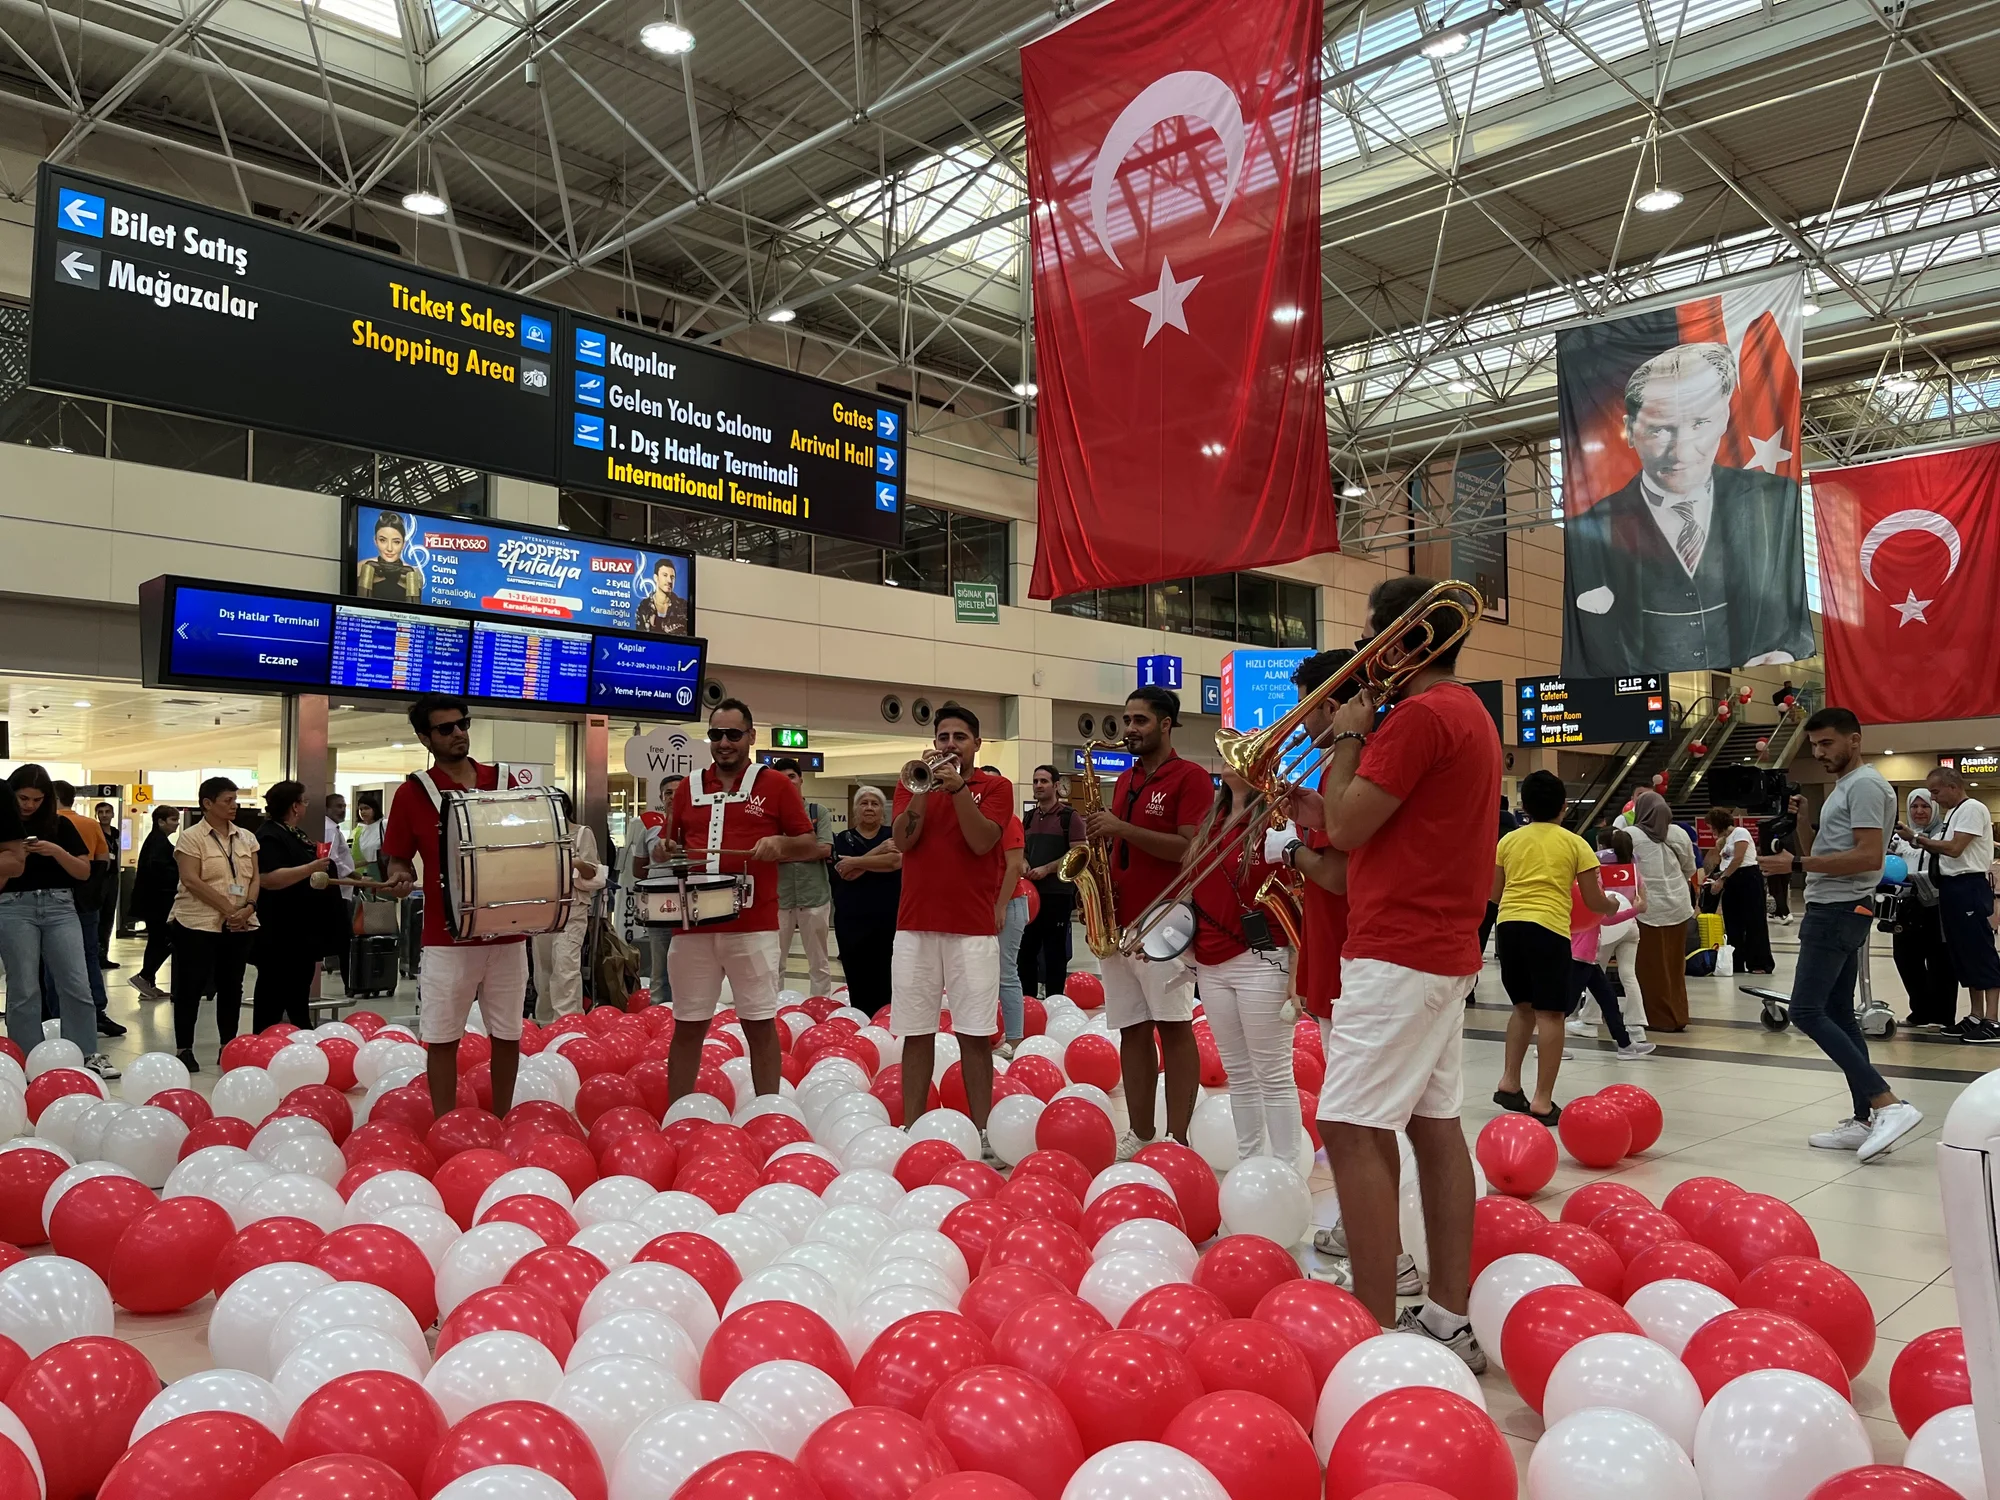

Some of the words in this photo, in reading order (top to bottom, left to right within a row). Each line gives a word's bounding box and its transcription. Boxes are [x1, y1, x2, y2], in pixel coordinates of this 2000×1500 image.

[110, 206, 176, 251] Bilet
[184, 231, 248, 276] Satış
[108, 259, 258, 320] Mağazalar
[390, 282, 454, 322] Ticket
[461, 303, 515, 339] Sales
[352, 321, 459, 375] Shopping
[465, 350, 515, 382] Area
[610, 342, 676, 380] Kapılar
[609, 385, 662, 418] Gelen
[667, 398, 712, 430] Yolcu
[717, 411, 772, 443] Salonu
[833, 402, 874, 431] Gates
[790, 430, 839, 460] Arrival
[845, 442, 873, 468] Hall
[609, 425, 625, 450] 1.
[631, 430, 659, 463] Dış
[665, 437, 719, 470] Hatlar
[724, 451, 798, 487] Terminali
[608, 457, 723, 501] International
[729, 482, 797, 516] Terminal
[804, 498, 810, 518] 1
[425, 537, 456, 549] MELEK
[522, 535, 566, 547] INTERNATIONAL
[507, 539, 579, 561] FOODFEST
[438, 555, 458, 564] Eylül
[432, 565, 457, 575] Cuma
[497, 548, 581, 588] Antalya
[592, 560, 632, 572] BURAY
[432, 575, 454, 585] 21.00
[612, 580, 630, 589] Eylül
[432, 587, 476, 599] Karaalioğlu
[592, 587, 631, 598] Cumartesi
[958, 588, 982, 598] SIĞINAK
[432, 597, 451, 605] Parkı
[522, 594, 538, 602] Eylül
[540, 596, 556, 604] 2023
[610, 600, 630, 608] 21.00
[958, 600, 985, 609] SHELTER
[503, 602, 542, 613] Karaalioğlu
[543, 607, 561, 615] Parkı
[591, 607, 630, 618] Karaalioğlu
[219, 608, 235, 622] Dış
[238, 610, 270, 623] Hatlar
[272, 613, 320, 628] Terminali
[613, 619, 630, 627] Parkı
[618, 642, 646, 653] Kapılar
[258, 653, 299, 667] Eczane
[1246, 660, 1265, 668] HIZLI
[617, 661, 676, 671] 4-5-6-7-209-210-211-212
[1264, 671, 1288, 679] ALANI
[1540, 681, 1565, 692] Kafeler
[1618, 678, 1641, 687] CIP
[614, 687, 633, 696] Yeme
[635, 687, 652, 697] İçme
[654, 690, 671, 698] Alanı
[1540, 691, 1568, 701] Cafeteria
[1253, 708, 1263, 726] 1
[1542, 713, 1562, 722] Prayer
[1542, 735, 1554, 743] Lost
[1556, 734, 1561, 743] &
[1563, 733, 1583, 742] Found
[649, 745, 664, 753] free
[647, 753, 693, 773] WiFi
[1101, 756, 1124, 766] Information
[1960, 757, 1998, 766] Asansör
[1961, 765, 1998, 773] Elevator
[103, 786, 111, 796] 6
[745, 804, 764, 813] ADEN
